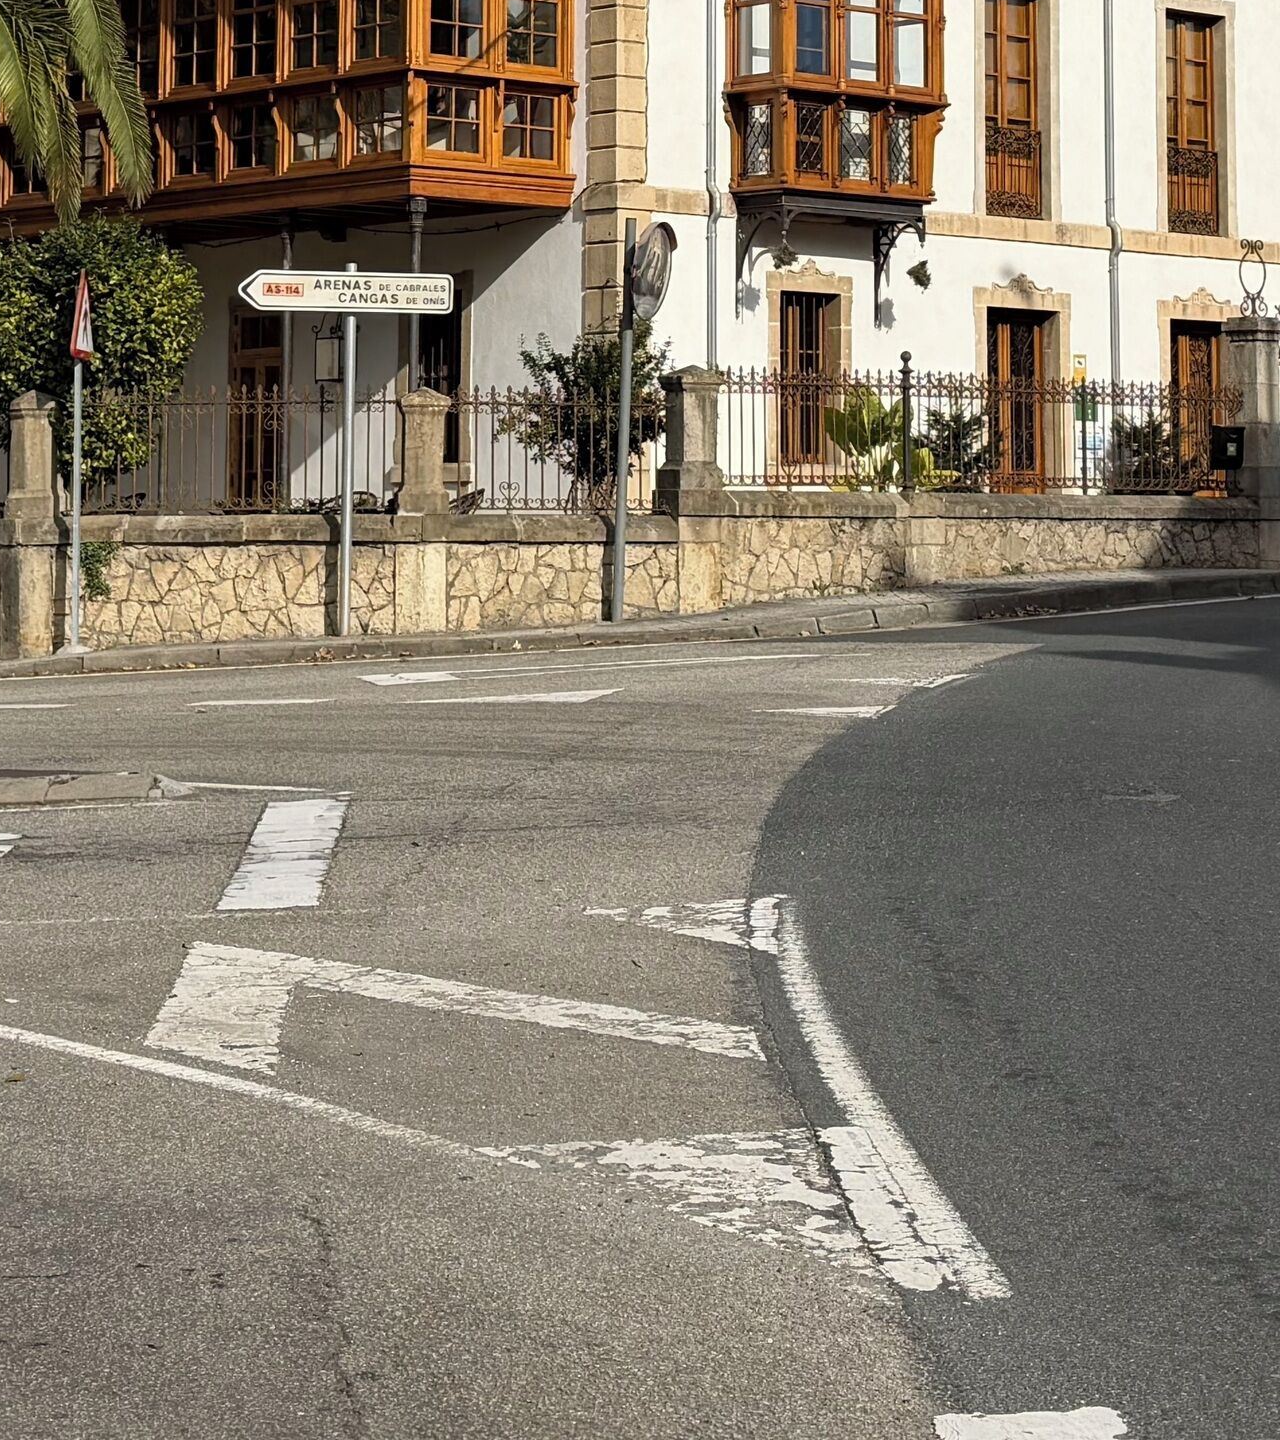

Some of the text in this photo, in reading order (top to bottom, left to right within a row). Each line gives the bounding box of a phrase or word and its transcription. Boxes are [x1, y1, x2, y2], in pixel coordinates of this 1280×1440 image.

[266, 284, 300, 295] AS-114
[313, 279, 446, 293] ARENAS DE CABRALES
[338, 292, 446, 306] CANGAS DE ONÍS
